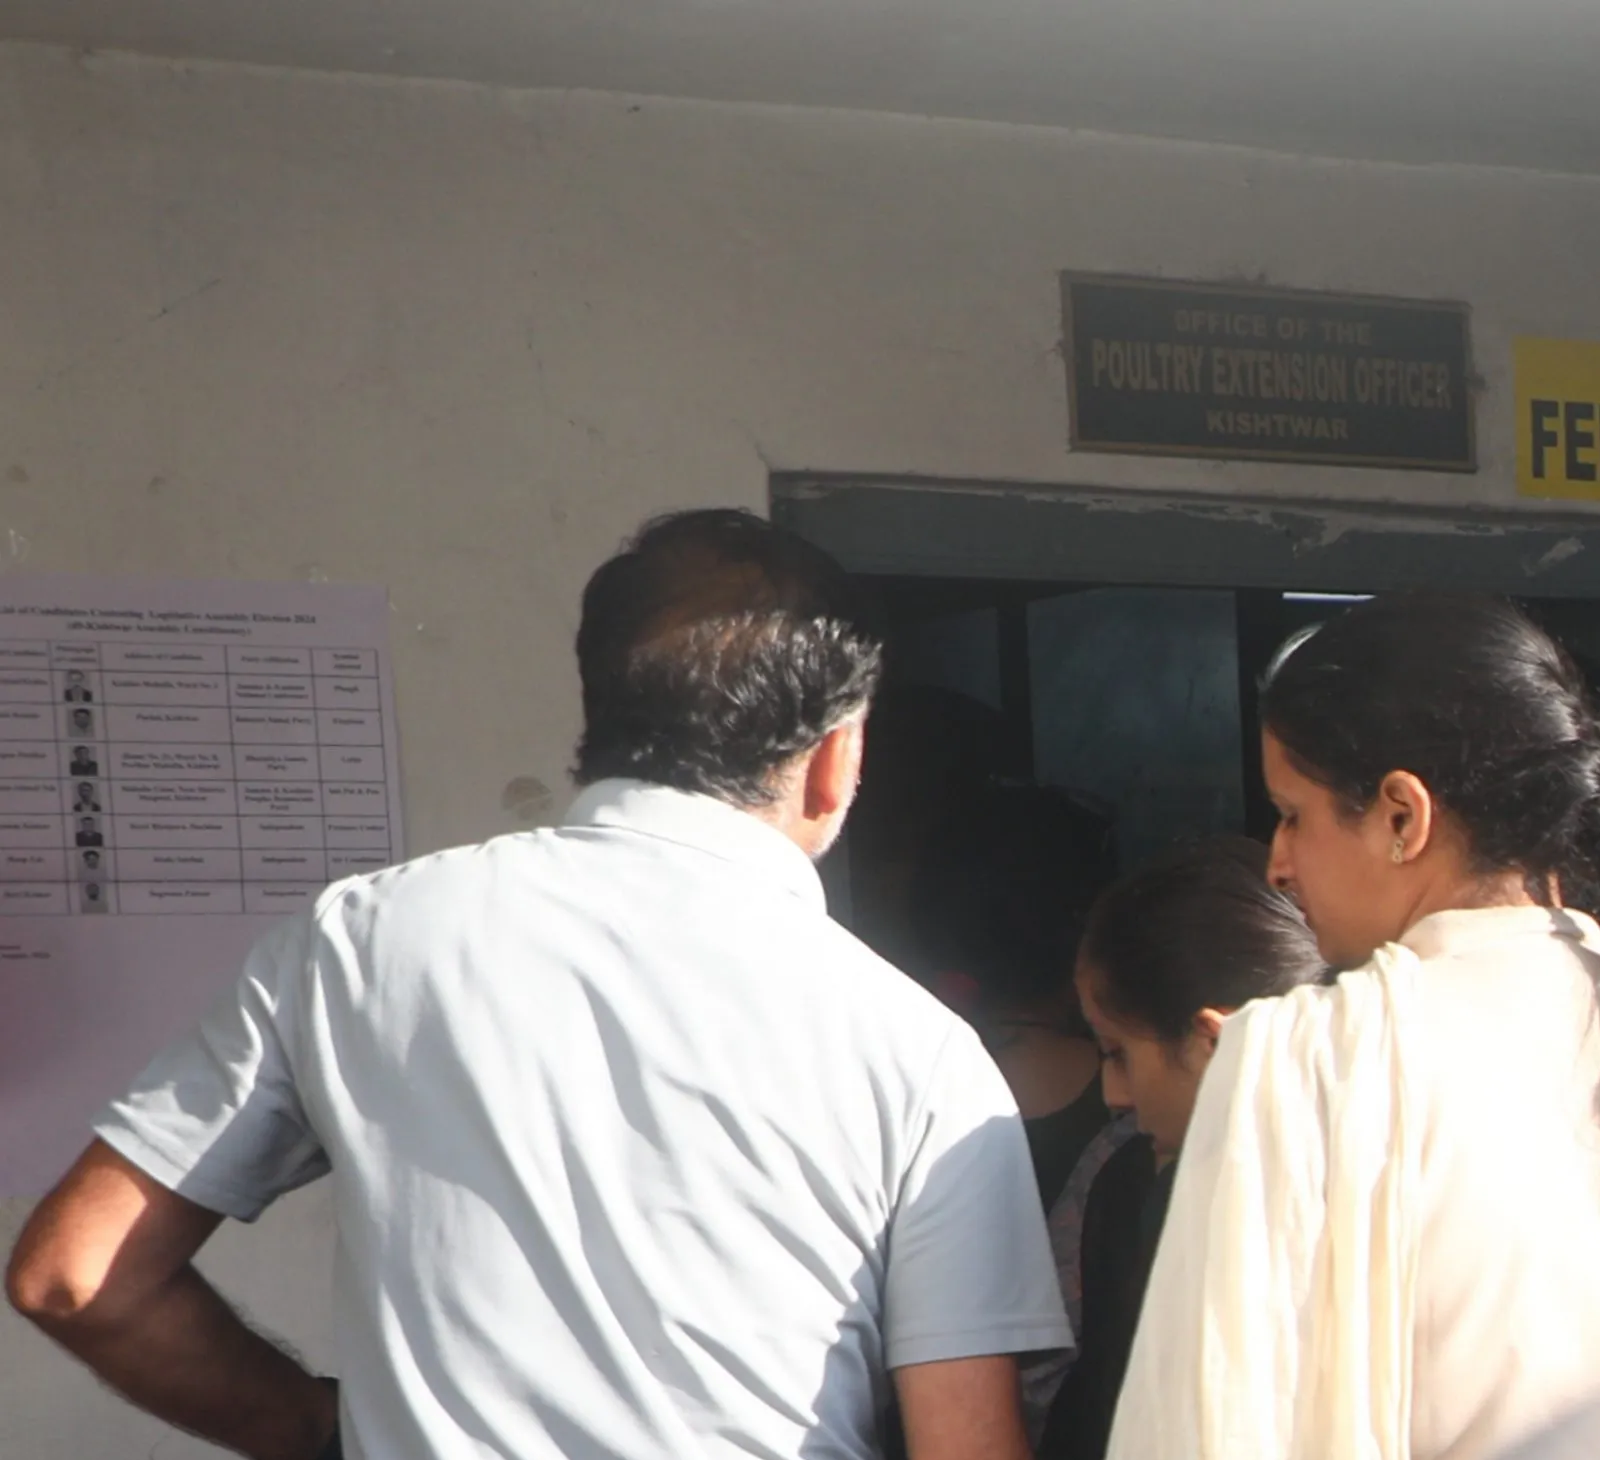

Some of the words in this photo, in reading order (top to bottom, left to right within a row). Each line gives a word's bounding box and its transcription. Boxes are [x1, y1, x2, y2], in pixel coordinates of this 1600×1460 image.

[1173, 309, 1268, 338] OFFICE
[1277, 317, 1309, 339] OF
[1321, 318, 1373, 347] THE
[1090, 338, 1203, 394] POULTRY
[1211, 347, 1348, 404] EXTENSION
[1354, 358, 1452, 410] OFFICER
[1206, 410, 1348, 441] KISHTWAR
